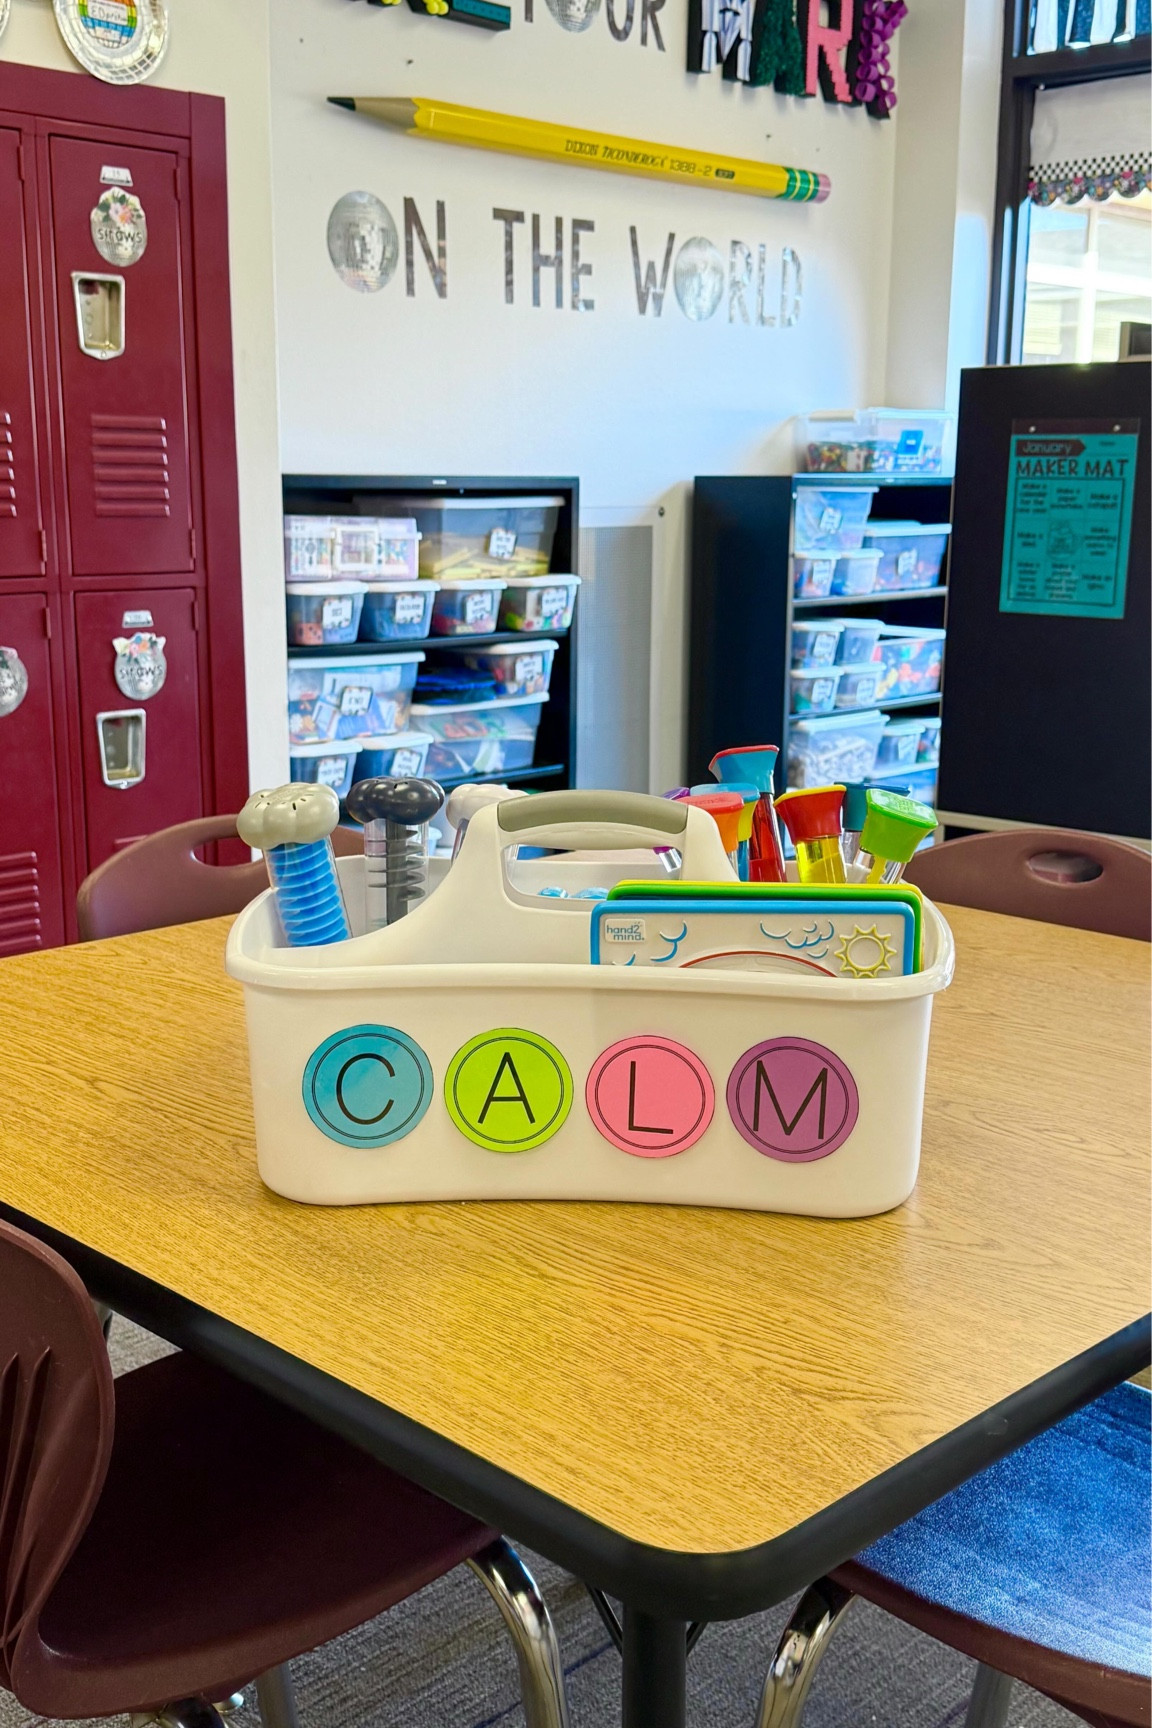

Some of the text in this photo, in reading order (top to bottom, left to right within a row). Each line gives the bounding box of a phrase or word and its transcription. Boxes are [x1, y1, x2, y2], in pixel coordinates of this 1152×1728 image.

[565, 139, 600, 156] DIXON
[327, 190, 802, 328] ON THE WORLD
[1022, 440, 1073, 455] January
[1016, 458, 1129, 477] MAKER MAT
[606, 924, 641, 934] hand2
[336, 1052, 828, 1140] CALM
